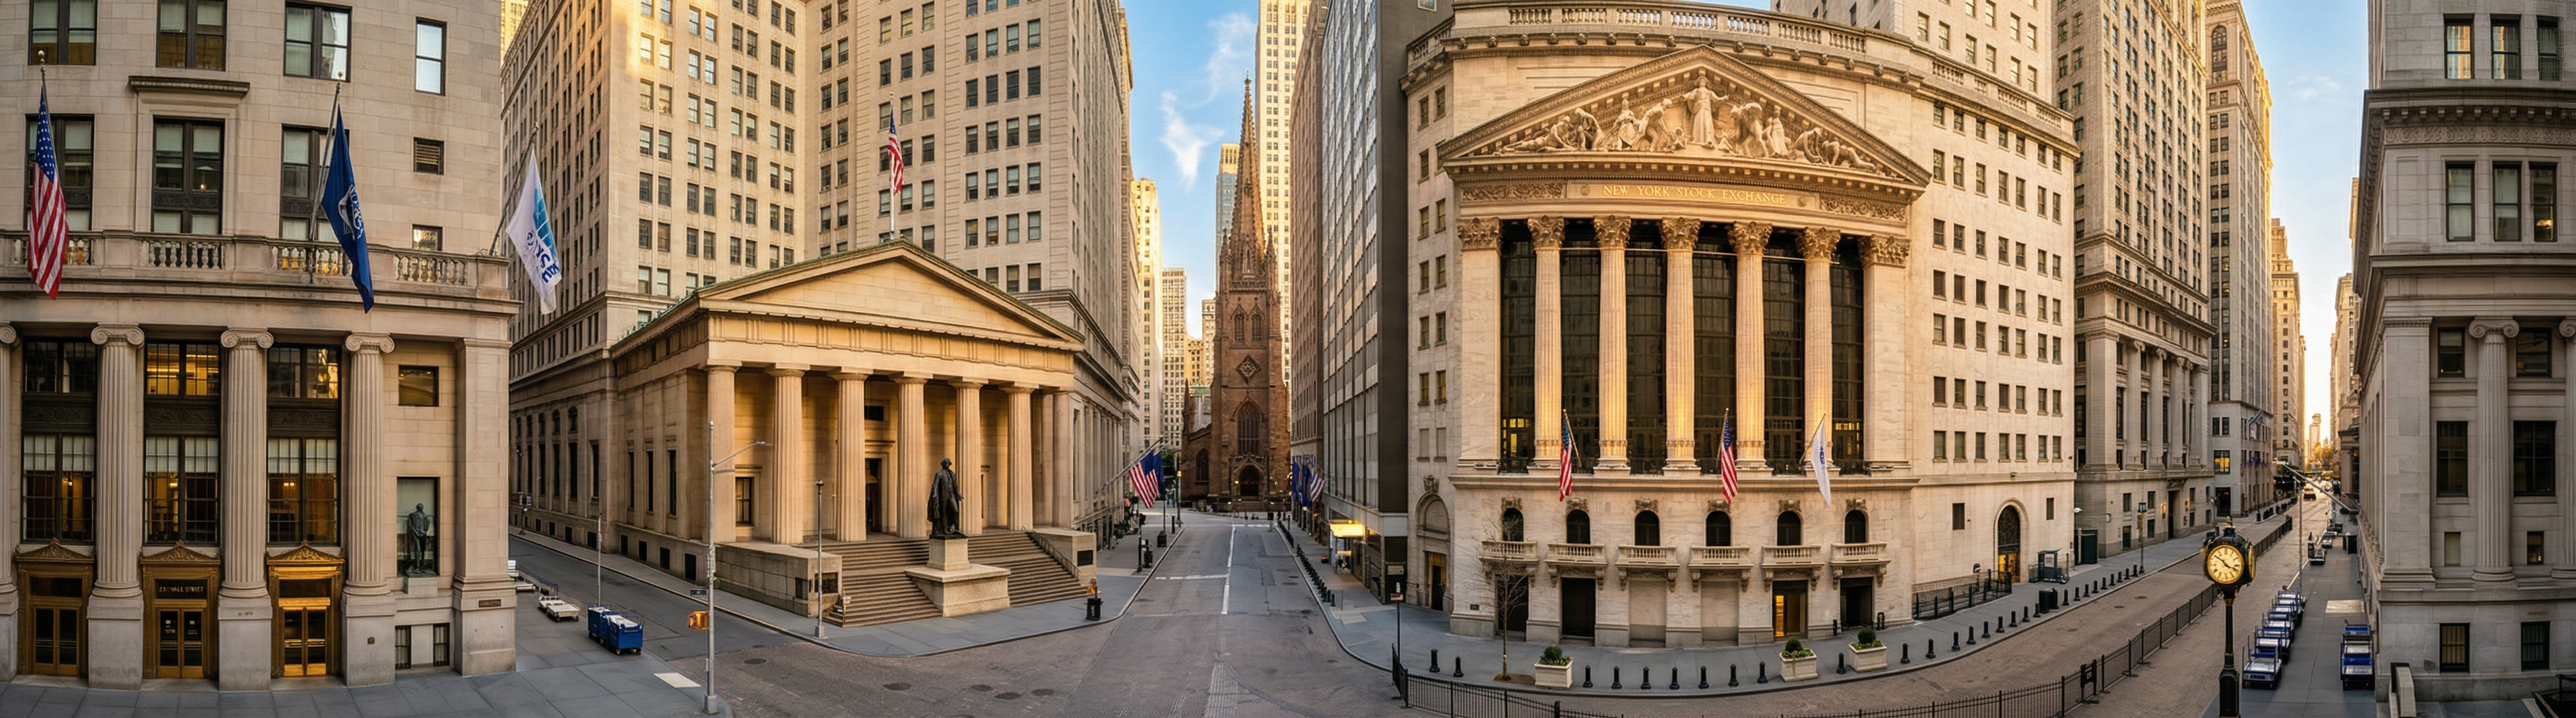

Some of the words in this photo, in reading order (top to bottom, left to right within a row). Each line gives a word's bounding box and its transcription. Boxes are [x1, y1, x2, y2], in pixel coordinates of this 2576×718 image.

[1603, 185, 1630, 195] NEW
[1636, 185, 1671, 197] YORK
[1676, 187, 1716, 199] STOCK
[1722, 189, 1786, 204] EXCHANGE
